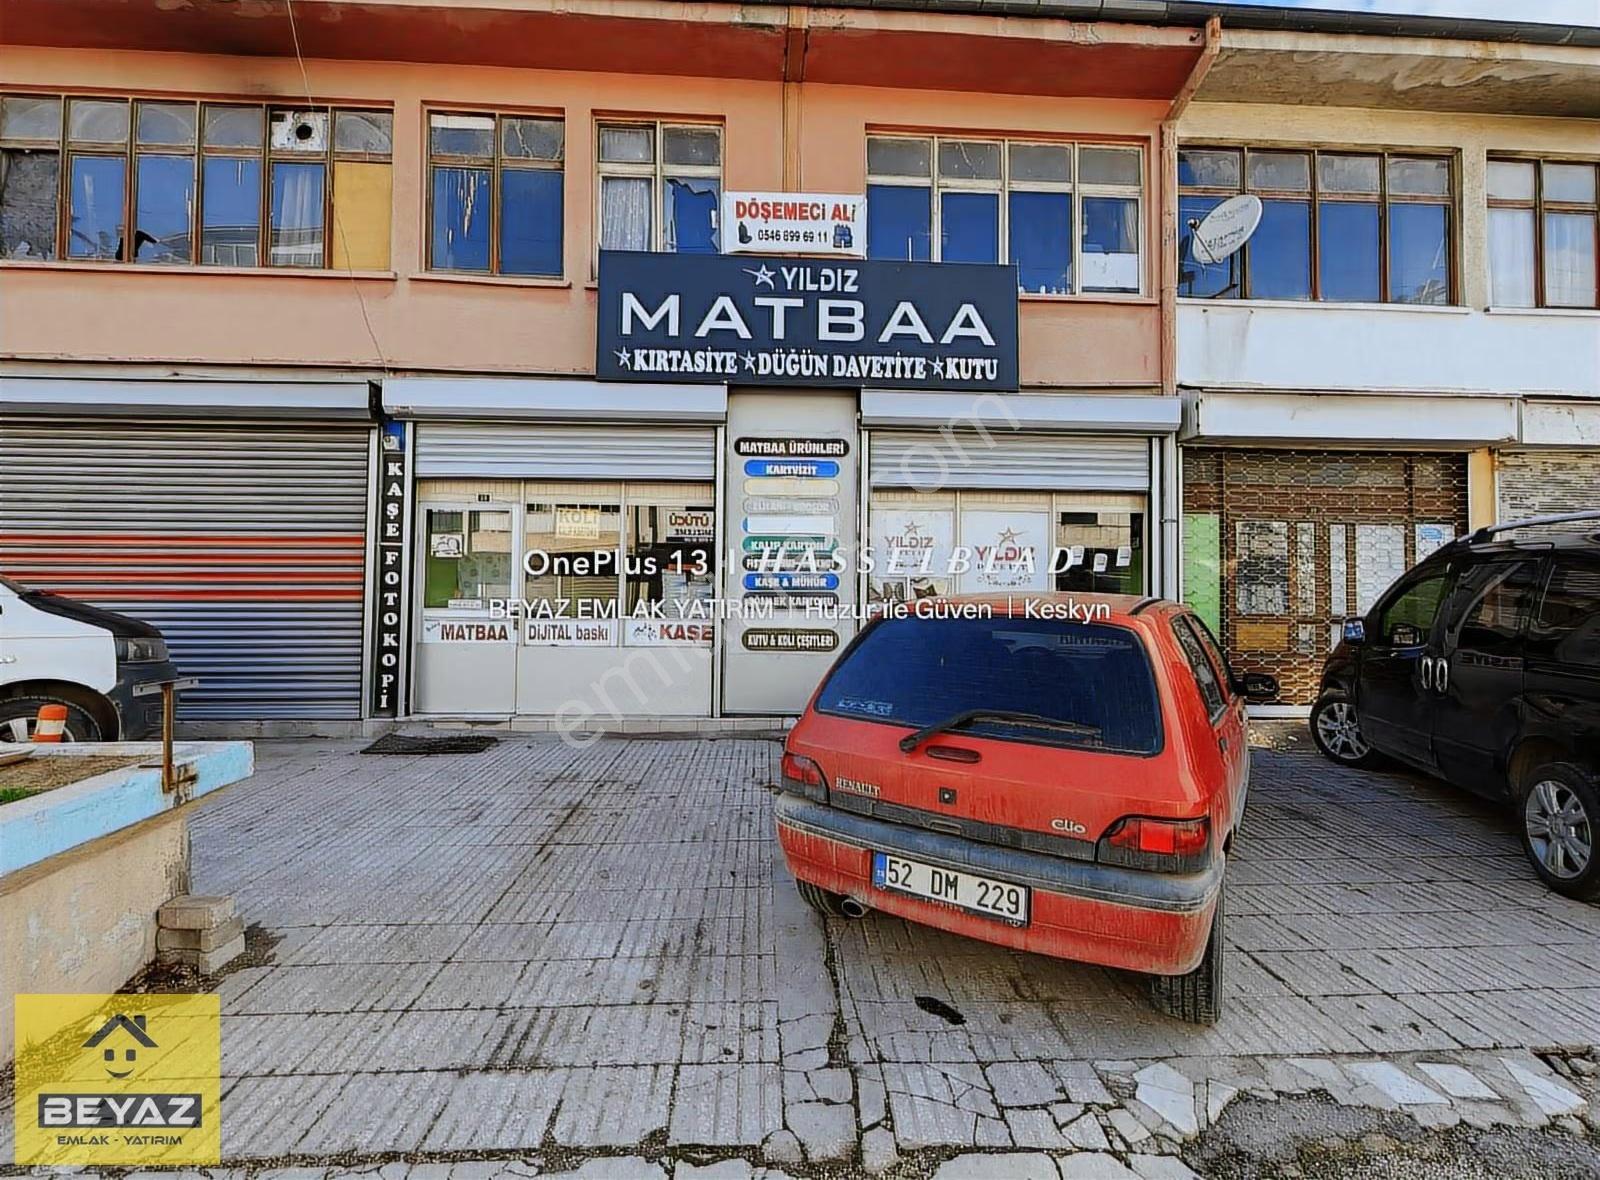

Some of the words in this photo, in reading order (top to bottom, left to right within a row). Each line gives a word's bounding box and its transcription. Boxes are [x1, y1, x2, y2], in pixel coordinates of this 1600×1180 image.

[757, 229, 780, 241] 0546
[783, 230, 801, 242] 899
[803, 231, 815, 243] 69
[818, 232, 828, 243] 11
[780, 267, 859, 292] YILDIZ
[621, 292, 997, 347] MATBAA
[633, 346, 738, 375] KIRTASİYE
[758, 349, 829, 378] DÜĞÜN
[832, 351, 927, 380] DAVETİYE
[945, 358, 998, 381] KUTU
[739, 442, 786, 453] MATBAA
[789, 440, 845, 455] ÜRÜNLERİ
[766, 464, 818, 475] KARTVİZİT
[885, 537, 934, 548] YILDIZ
[441, 624, 508, 641] MATBAA
[836, 776, 881, 798] RENAULT
[888, 860, 912, 888] 52
[931, 870, 958, 900] DM
[977, 881, 1020, 915] 229
